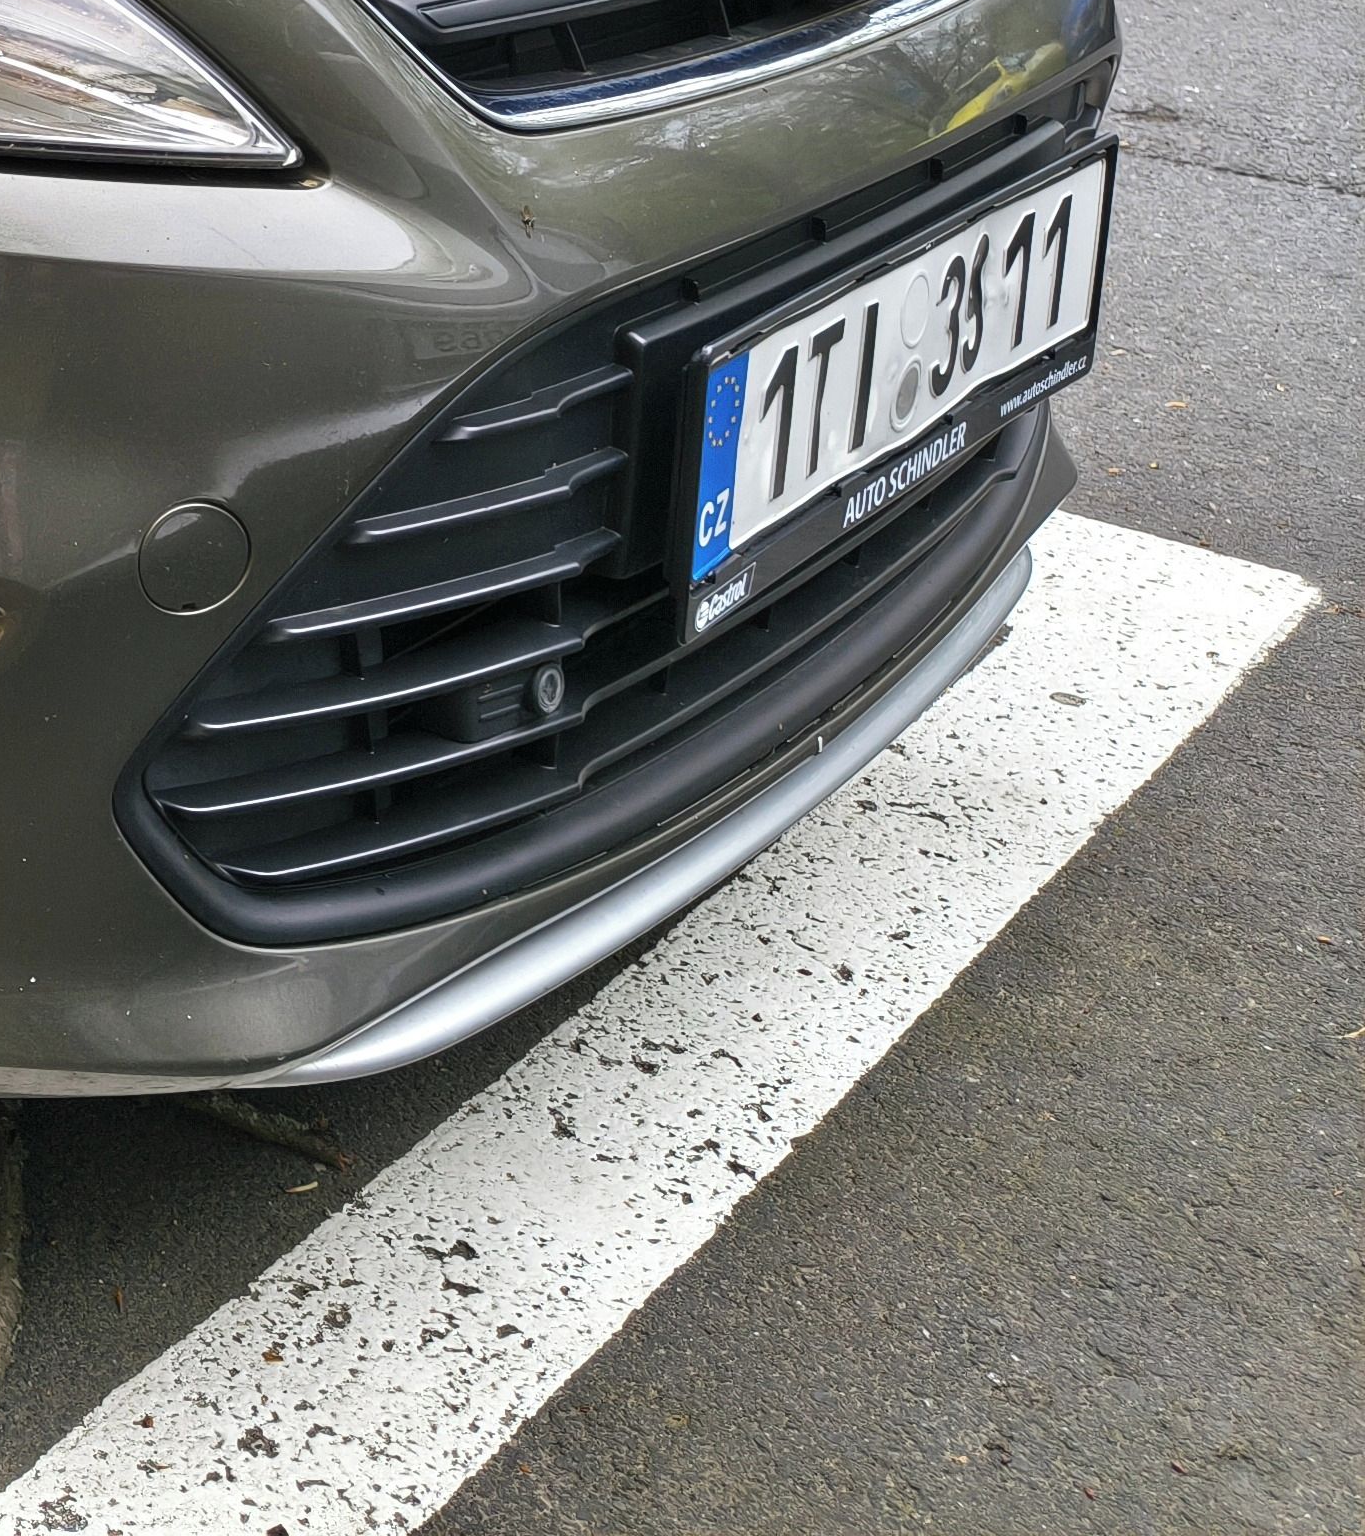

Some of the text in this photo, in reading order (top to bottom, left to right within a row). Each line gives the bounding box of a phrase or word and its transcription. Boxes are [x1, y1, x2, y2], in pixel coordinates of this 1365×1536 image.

[999, 354, 1088, 418] www.autoschindler.cz
[841, 421, 968, 529] AUTO SCHINDLER
[697, 487, 731, 549] CZ
[707, 572, 749, 618] Castrol
